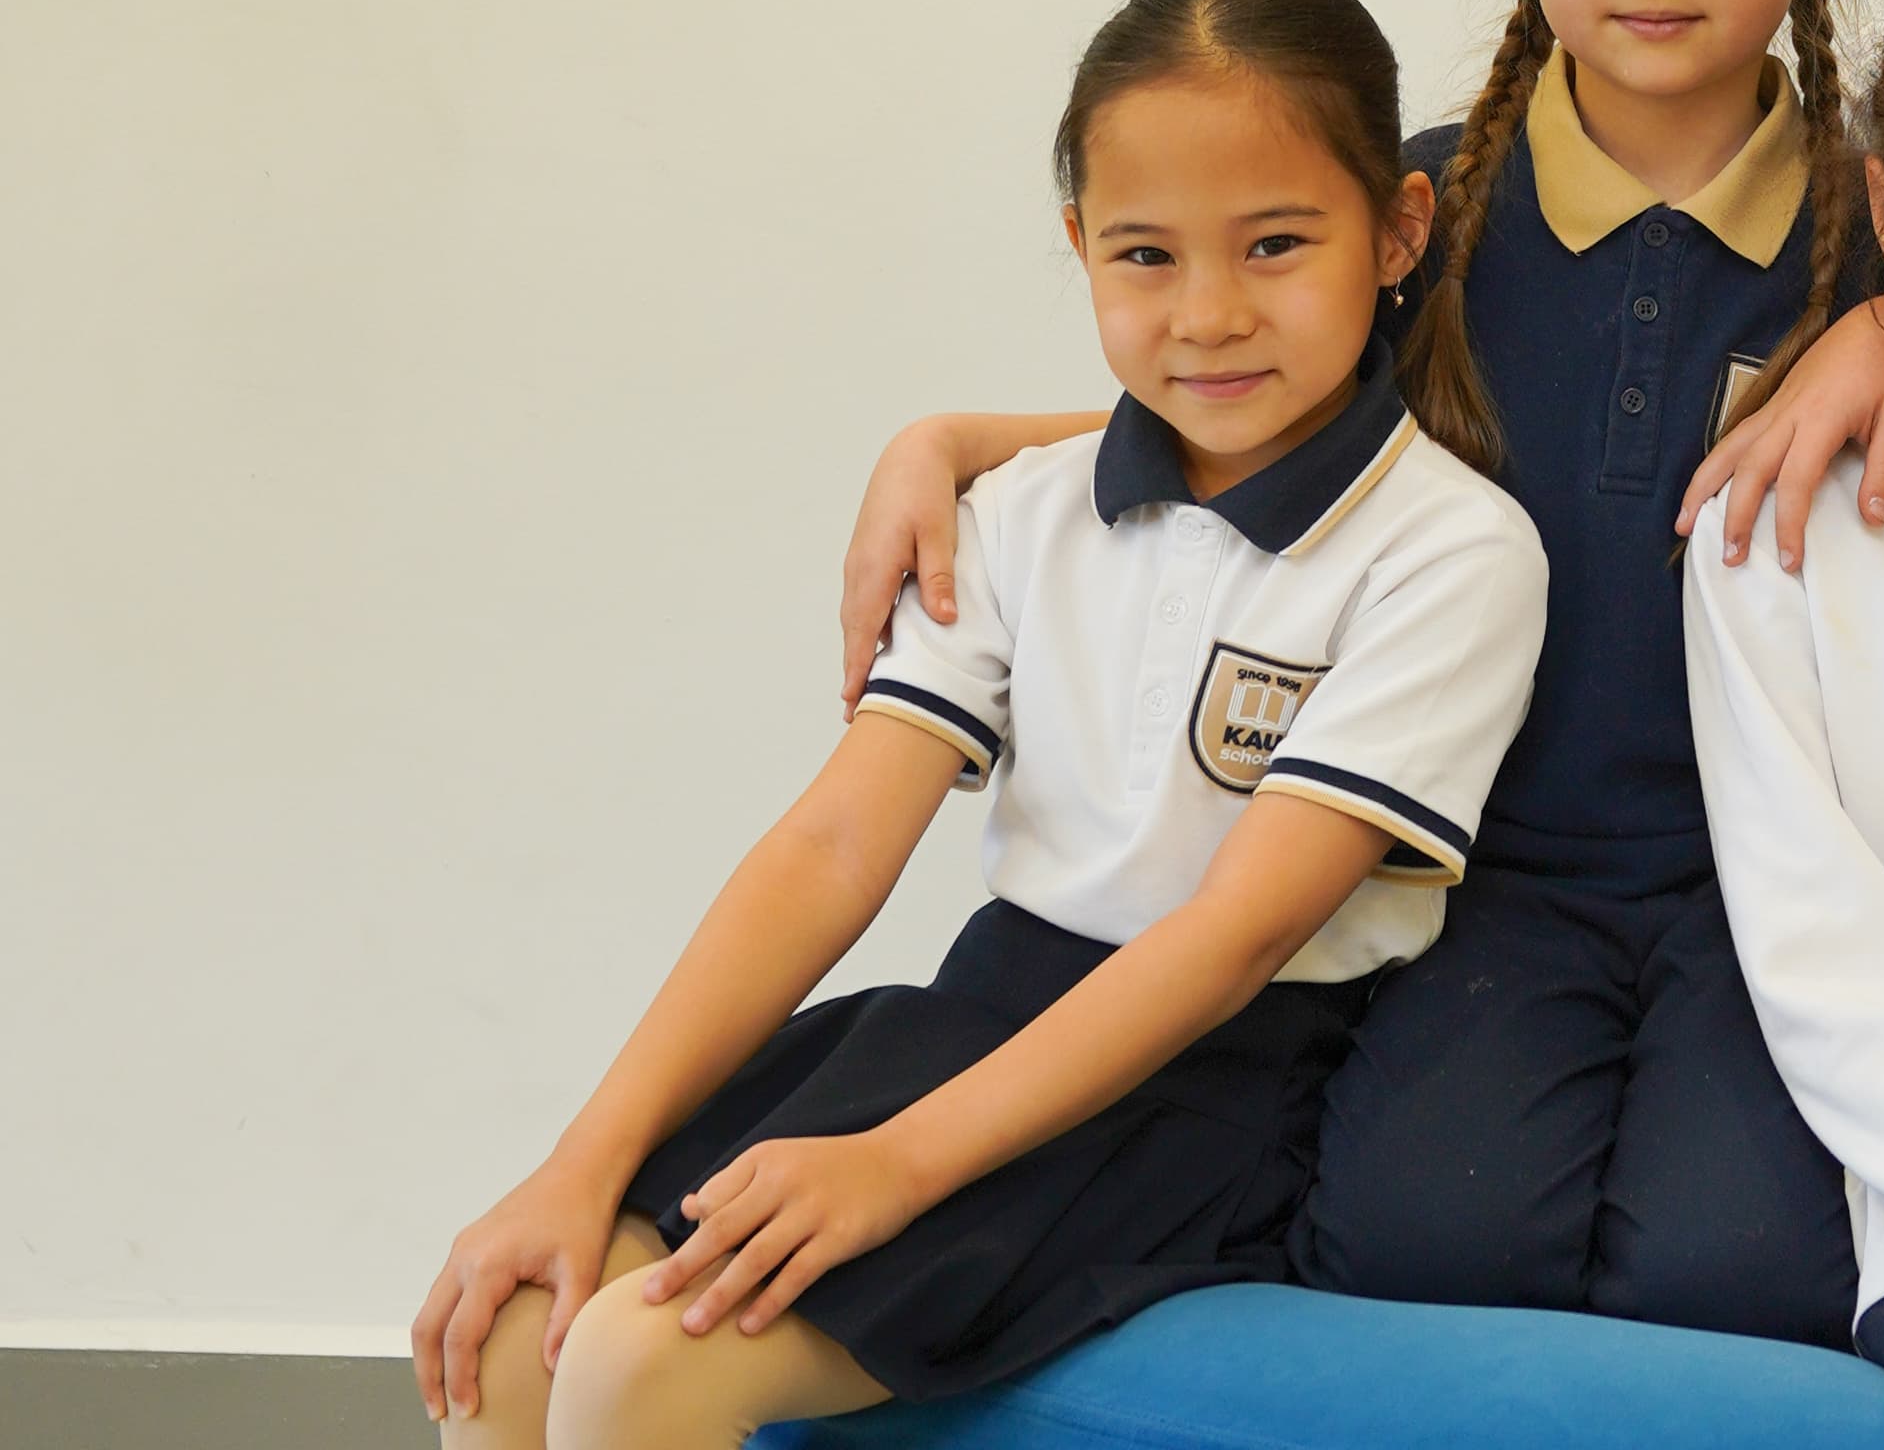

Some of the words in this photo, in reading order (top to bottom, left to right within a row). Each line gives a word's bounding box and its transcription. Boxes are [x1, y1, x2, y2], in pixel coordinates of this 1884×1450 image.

[1236, 668, 1271, 684] since
[1223, 726, 1287, 751] KAU
[1219, 748, 1273, 766] schoo
